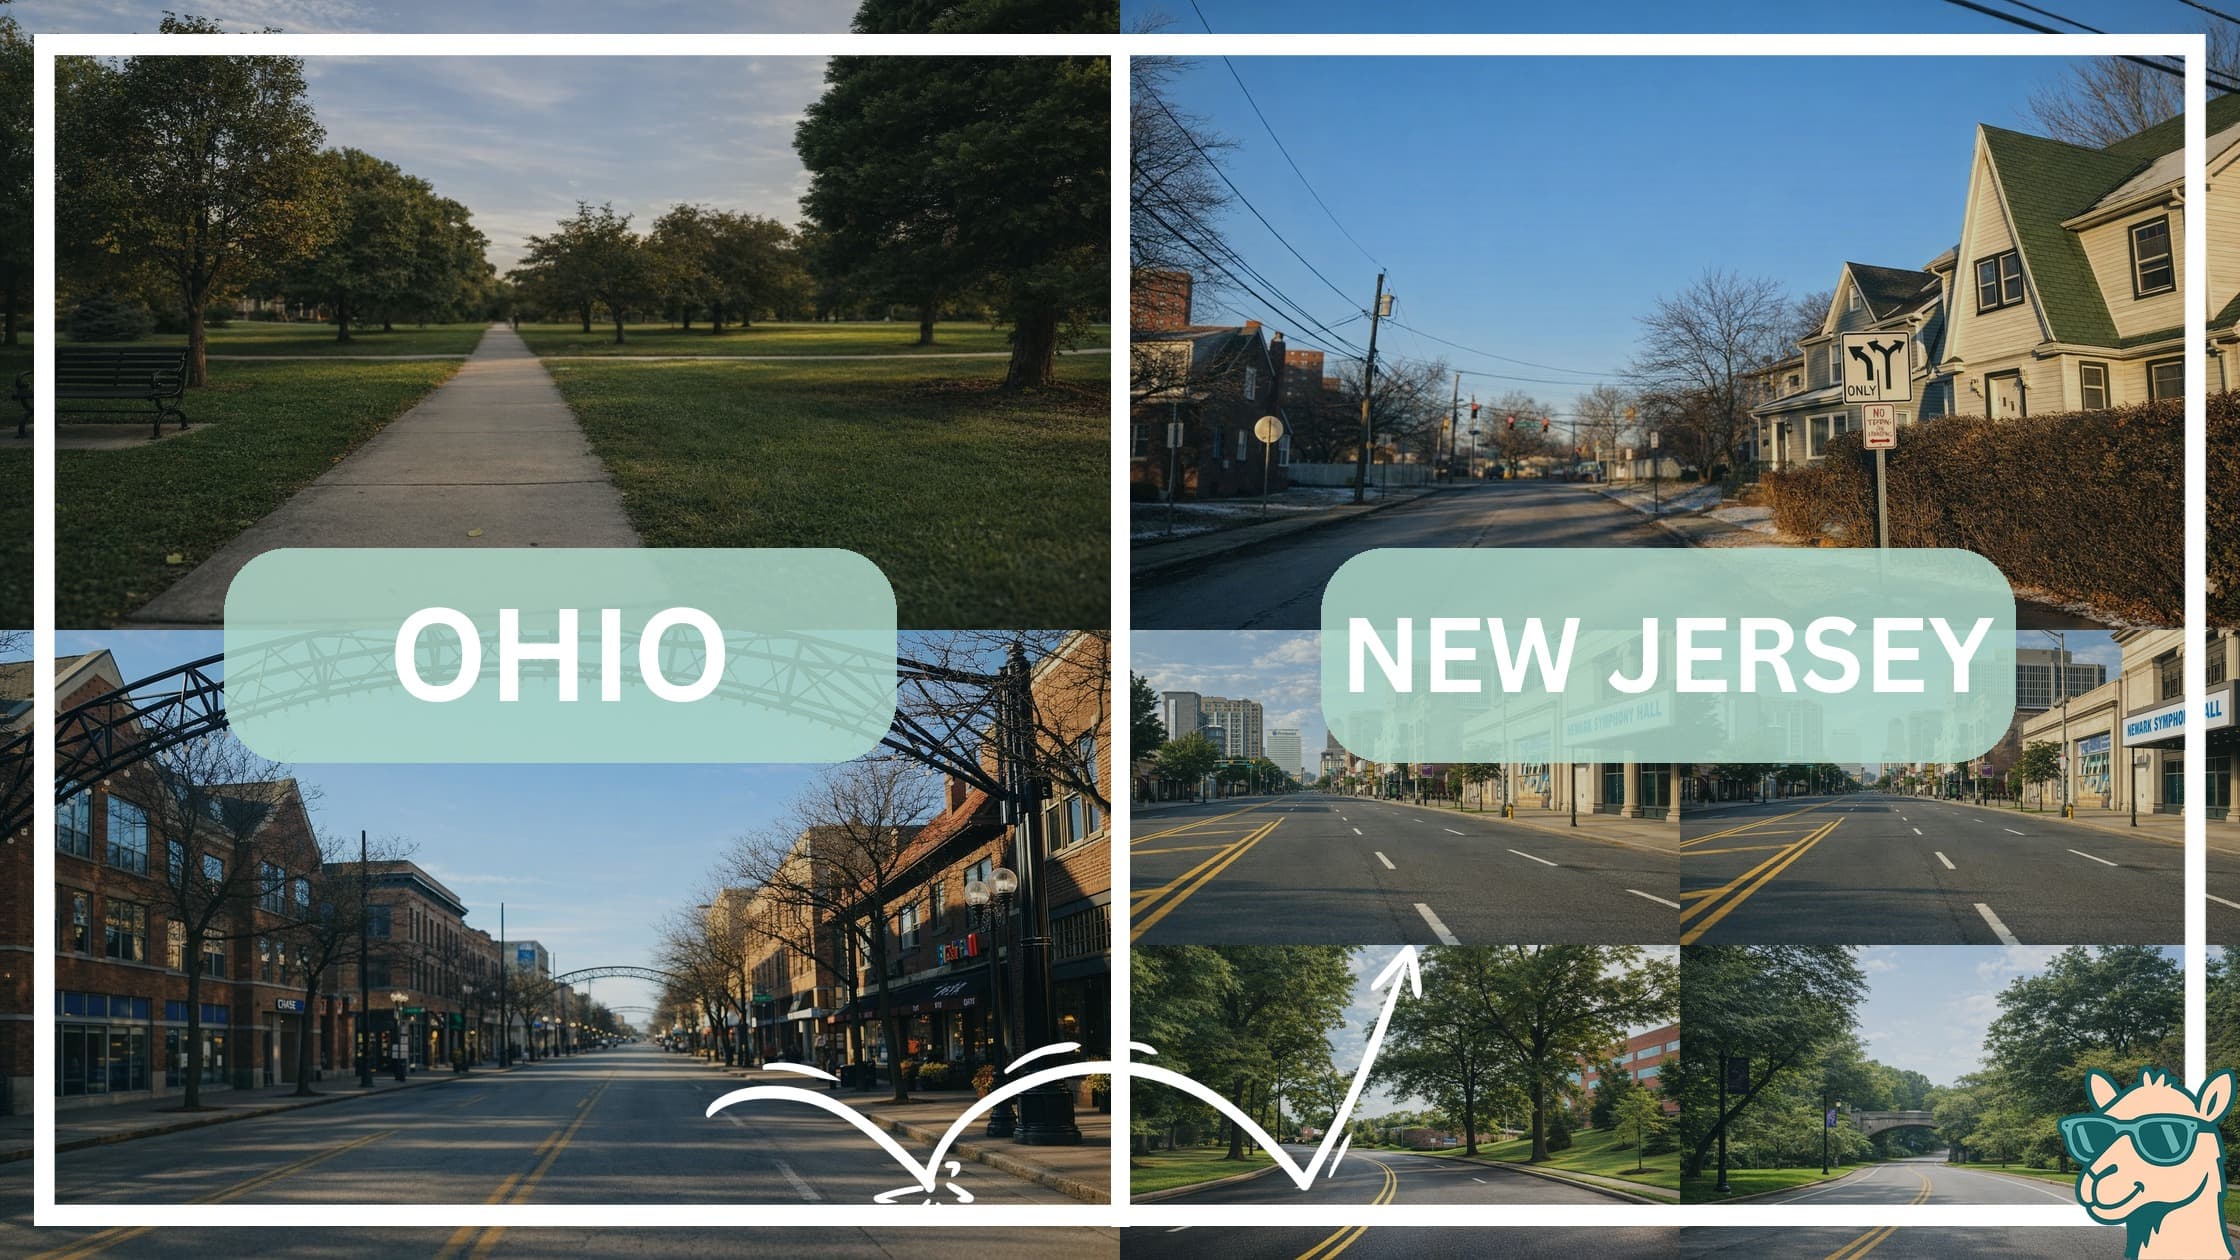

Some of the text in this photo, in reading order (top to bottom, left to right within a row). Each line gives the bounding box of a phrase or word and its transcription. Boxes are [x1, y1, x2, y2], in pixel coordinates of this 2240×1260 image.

[1847, 385, 1877, 397] ONLY
[1873, 408, 1885, 417] NO
[1637, 701, 1663, 720] HALL
[2127, 700, 2222, 737] NEWARK SYMPHO ALL
[278, 999, 296, 1009] CHASE
